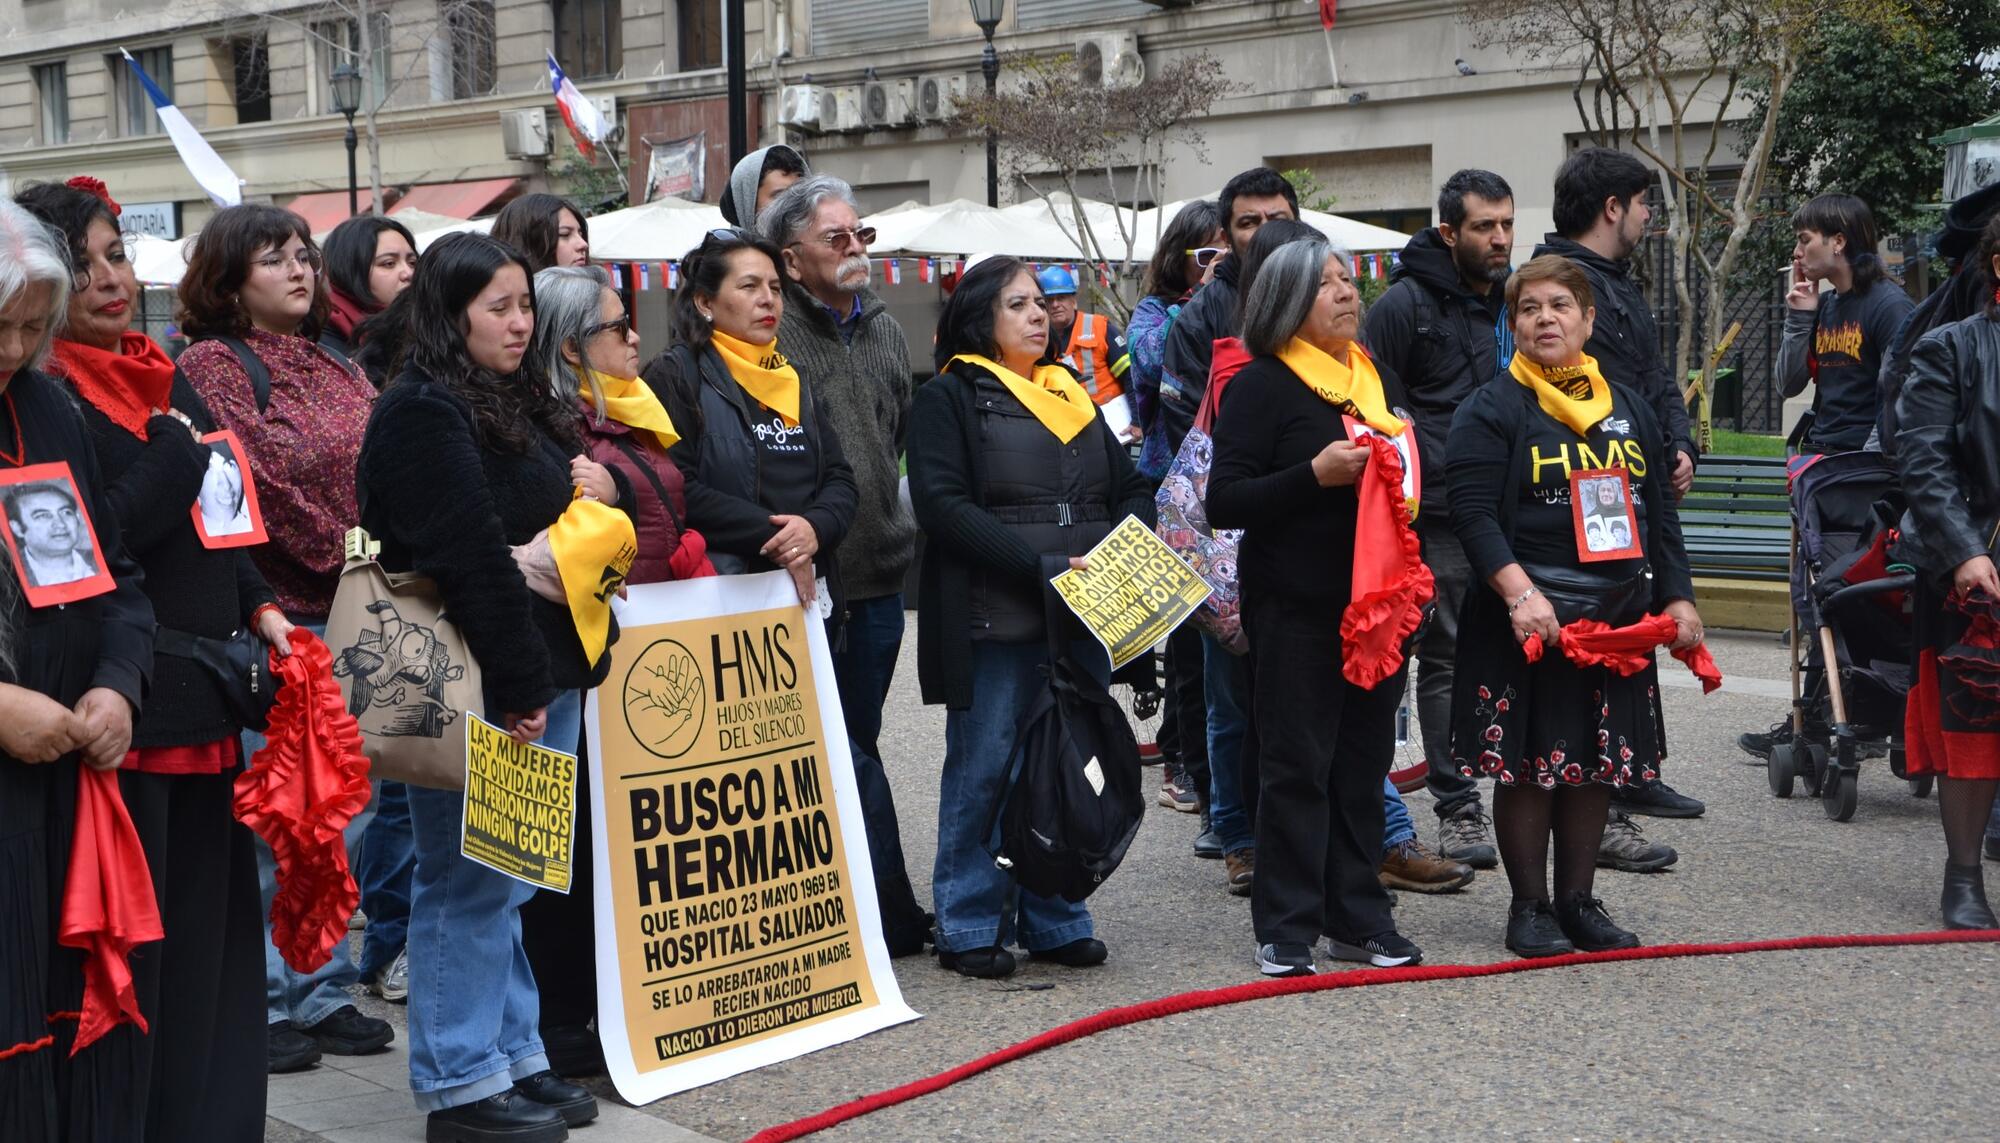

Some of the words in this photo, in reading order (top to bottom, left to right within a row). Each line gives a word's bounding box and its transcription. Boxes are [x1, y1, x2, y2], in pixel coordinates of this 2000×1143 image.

[1531, 439, 1647, 483] HMS
[1056, 576, 1080, 598] LAS
[1077, 521, 1144, 585] MUJERES
[1069, 595, 1091, 613] NO
[1085, 535, 1159, 601] OLVIDAMOS
[1084, 610, 1102, 631] NI
[1100, 550, 1175, 621] PERDONAMOS
[1141, 562, 1194, 612] GOLPE
[711, 623, 797, 702] HMS
[717, 701, 755, 726] HIJOS
[756, 700, 762, 718] Y
[764, 692, 803, 716] MADRES
[719, 726, 752, 751] DEL
[753, 714, 805, 745] SILENCIO
[470, 747, 488, 775] NO
[491, 758, 570, 808] OLVIDAMOS
[471, 720, 492, 752] LAS
[497, 736, 573, 783] MUJERES
[470, 772, 482, 801] NI
[485, 780, 569, 836] PERDONAMOS
[629, 768, 766, 843] BUSCO
[774, 763, 792, 816] A
[791, 755, 823, 810] MI
[519, 825, 568, 862] GOLPE
[634, 809, 834, 907] HERMANO
[640, 909, 680, 937] QUE
[685, 897, 737, 927] NACIO
[741, 894, 757, 915] 23
[761, 882, 798, 909] MAYO
[800, 876, 825, 899] 1969
[828, 870, 840, 891] EN
[643, 921, 755, 973] HOSPITAL
[759, 895, 846, 946] SALVADOR
[652, 990, 671, 1010] SE
[674, 984, 693, 1005] LO
[697, 960, 789, 1000] ARREBATARON
[792, 957, 801, 975] A
[802, 952, 816, 972] MI
[818, 941, 852, 967] MADRE
[713, 990, 760, 1018] RECIEN
[763, 975, 812, 1004] NACIDO
[660, 1029, 705, 1058] NACIO
[707, 1026, 717, 1044] Y
[719, 1021, 735, 1040] LO
[738, 1010, 784, 1034] DIERON
[786, 1002, 809, 1023] POR
[811, 985, 860, 1018] MUERTO.
